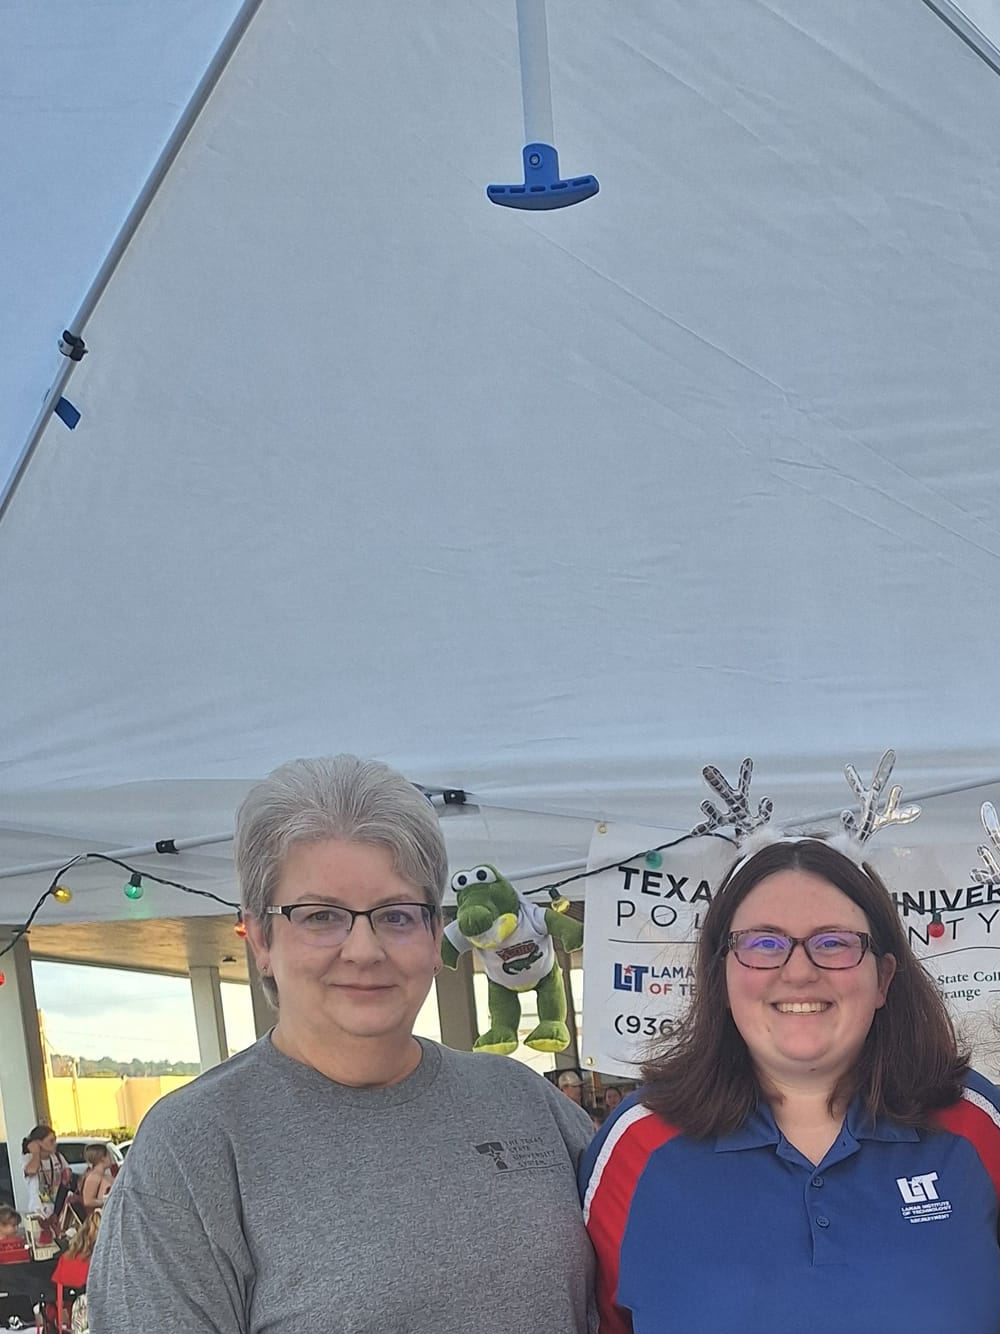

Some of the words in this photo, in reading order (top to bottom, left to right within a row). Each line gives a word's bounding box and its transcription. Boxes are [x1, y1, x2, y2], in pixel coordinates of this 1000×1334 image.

[618, 866, 714, 905] TEXA
[617, 900, 704, 930] POL
[651, 966, 696, 979] LAMA
[937, 971, 969, 985] State
[649, 983, 673, 995] OF
[939, 986, 981, 1001] range
